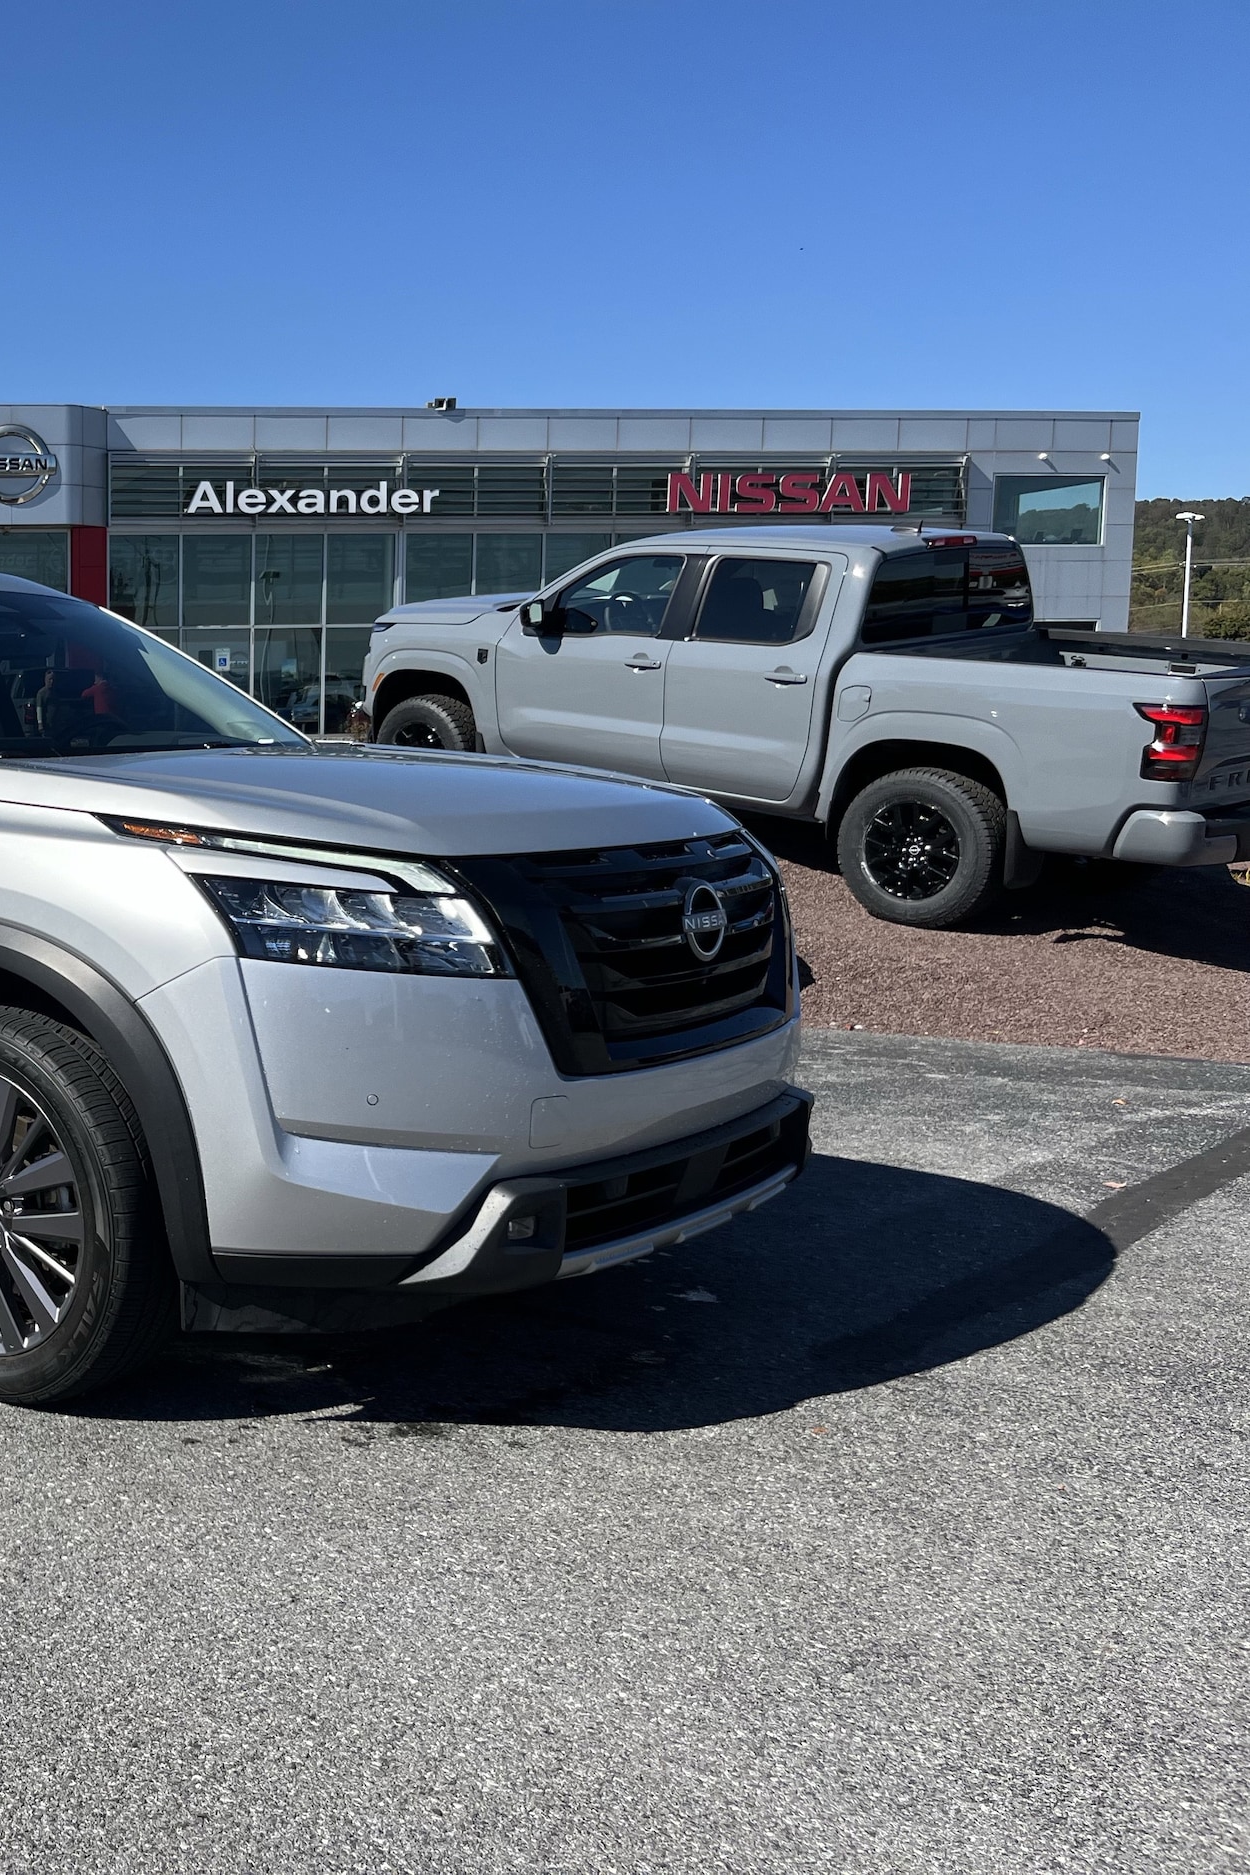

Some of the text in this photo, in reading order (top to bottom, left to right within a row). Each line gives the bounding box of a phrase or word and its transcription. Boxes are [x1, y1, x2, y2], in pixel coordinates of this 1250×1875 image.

[186, 480, 440, 514] Alexander
[666, 472, 912, 513] NISSAN
[1208, 769, 1250, 791] FR
[684, 914, 723, 930] NISSA
